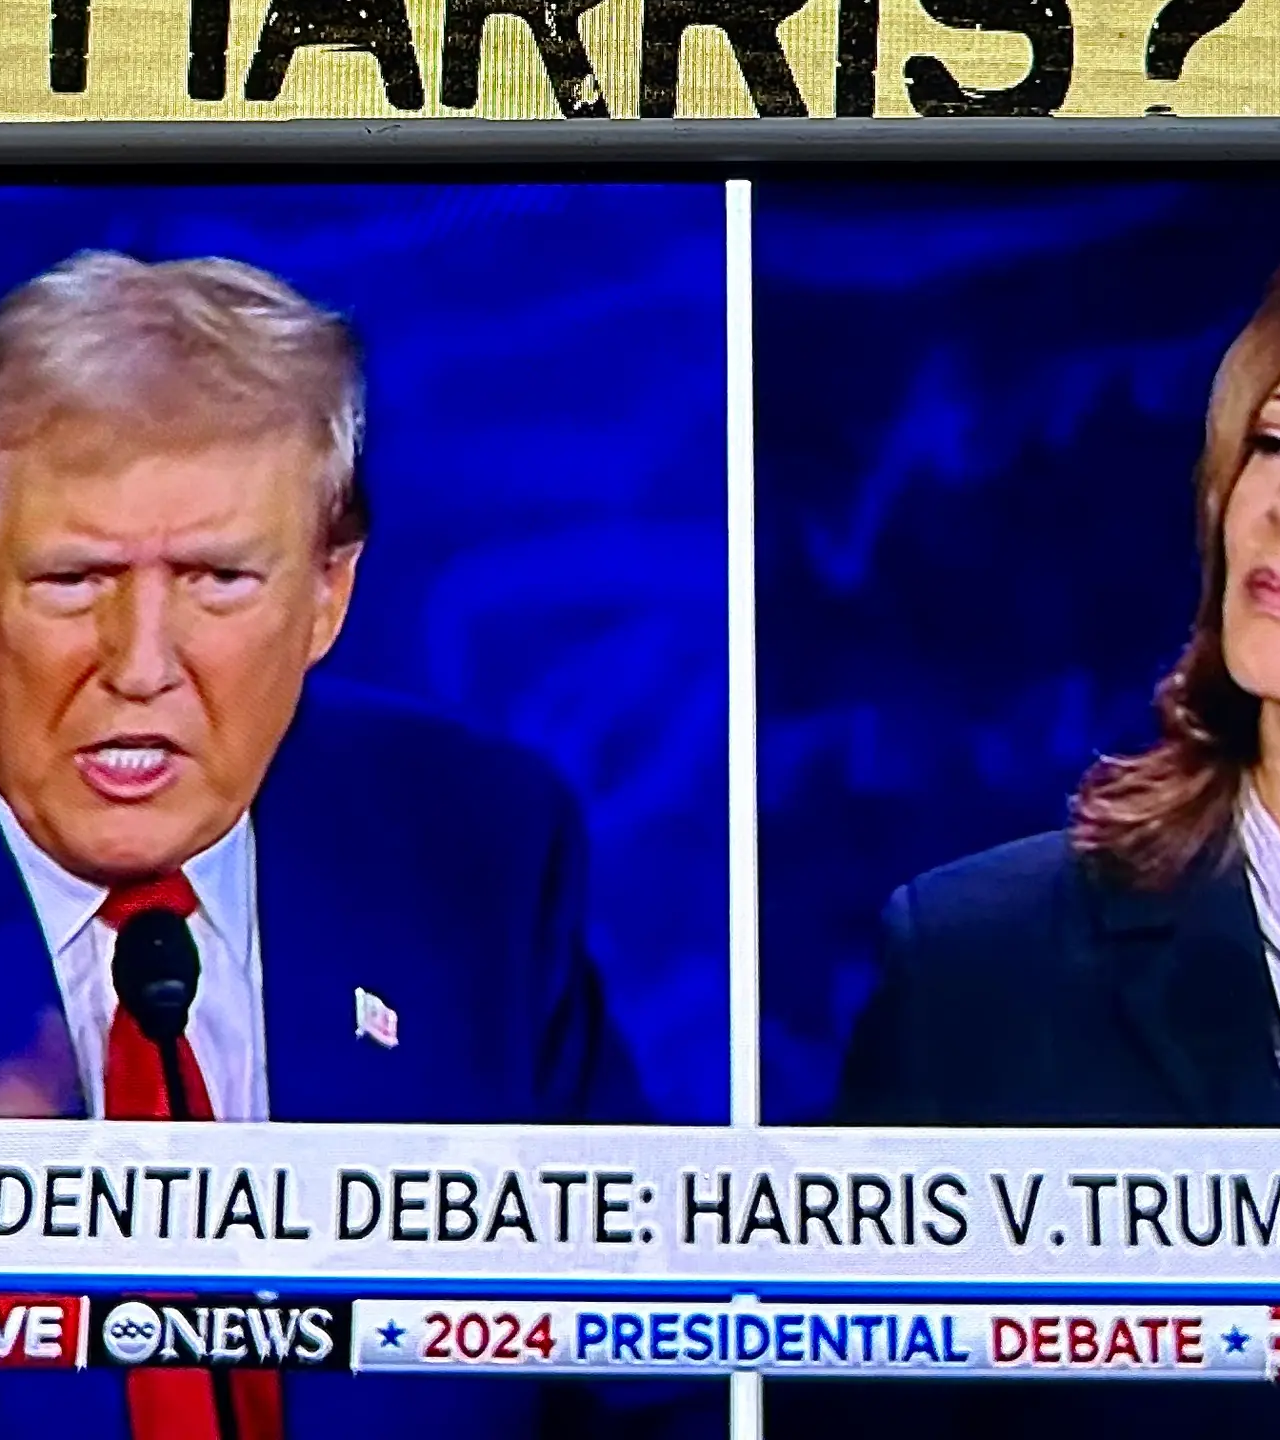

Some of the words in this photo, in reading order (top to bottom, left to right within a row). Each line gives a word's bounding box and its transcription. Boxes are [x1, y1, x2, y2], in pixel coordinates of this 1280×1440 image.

[336, 1168, 653, 1244] DEBATE:
[683, 1171, 969, 1246] HARRIS
[162, 1305, 333, 1362] NEWS
[423, 1311, 555, 1359] 2024
[575, 1311, 970, 1363] PRESIDENTIAL
[990, 1315, 1205, 1364] DEBATE
